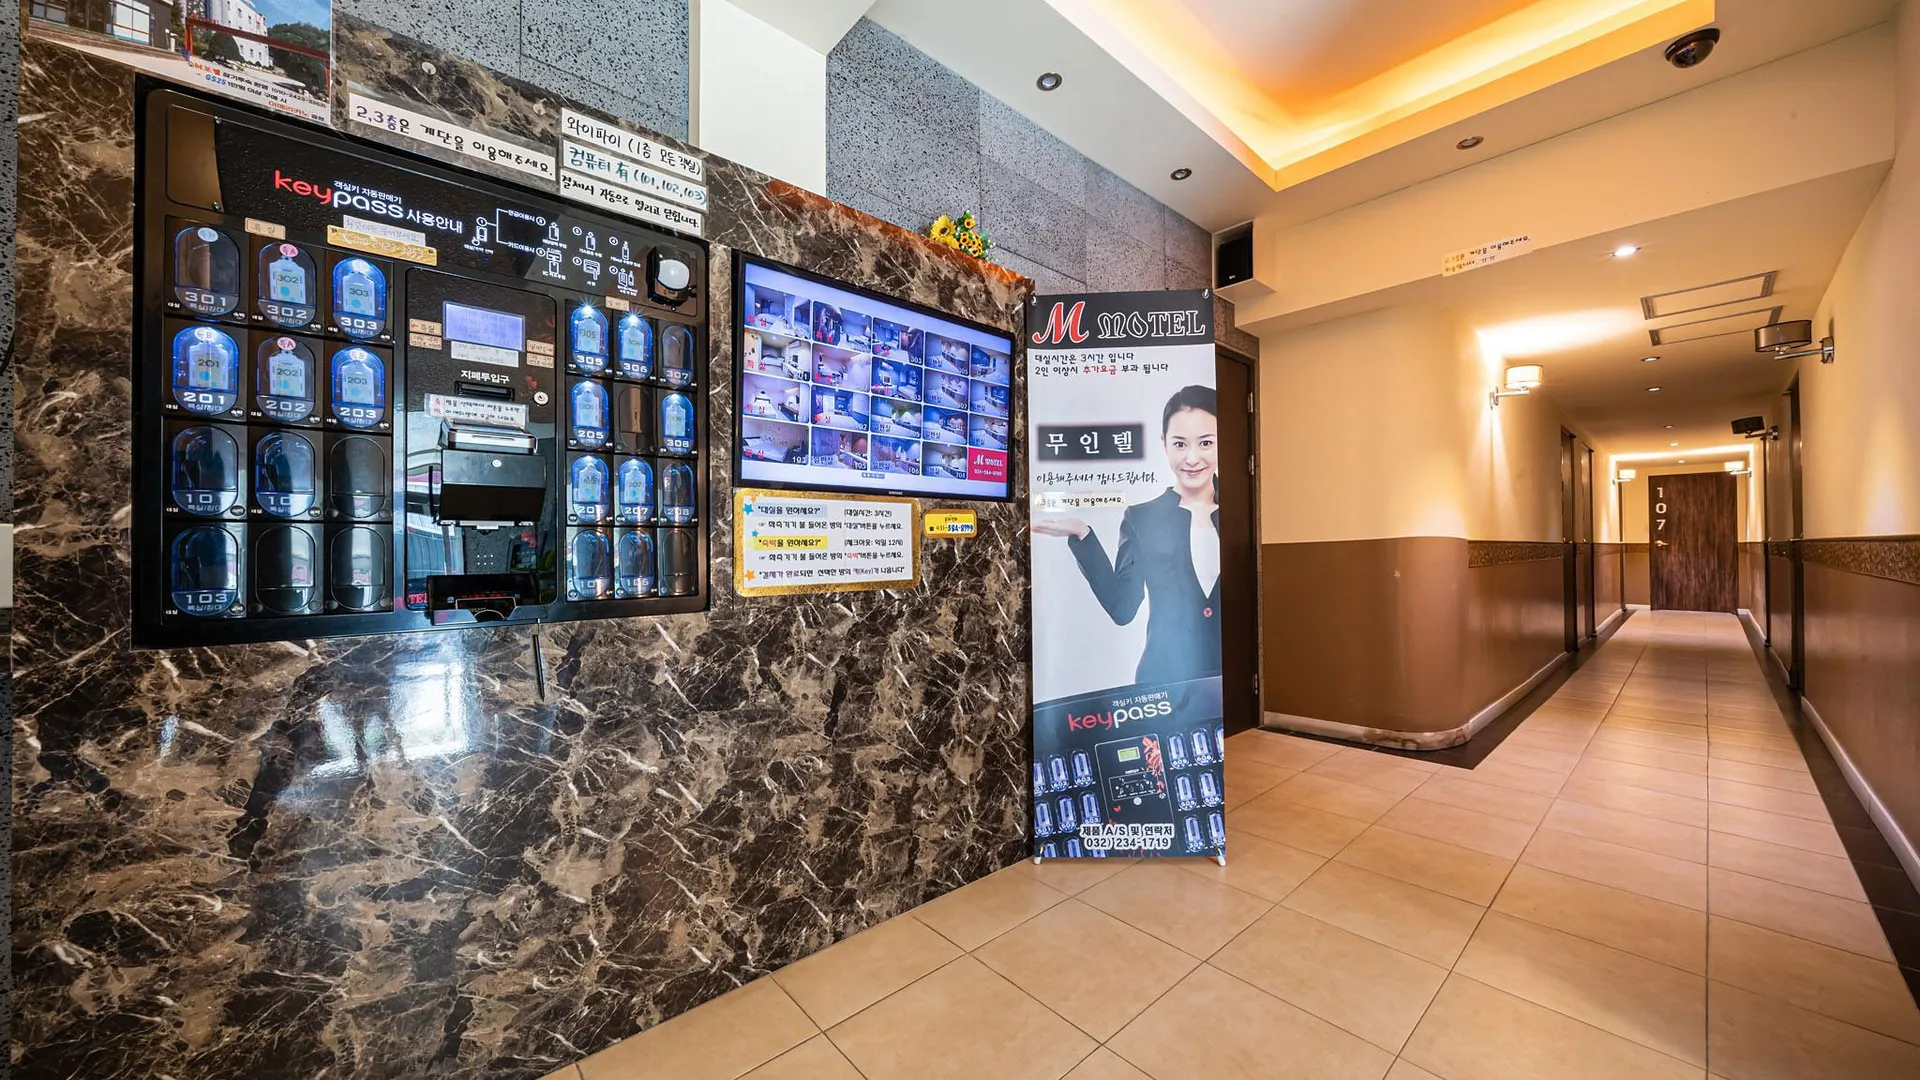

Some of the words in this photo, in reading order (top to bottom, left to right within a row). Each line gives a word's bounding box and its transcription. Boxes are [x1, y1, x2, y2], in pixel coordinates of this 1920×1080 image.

[205, 74, 226, 86] GS25
[356, 105, 410, 135] 2,3층은
[420, 124, 465, 152] 계단을
[472, 141, 554, 176] 이용해주세요.
[567, 116, 622, 148] 와이파이
[660, 149, 676, 167] 모든
[616, 161, 630, 183] 有
[274, 169, 404, 220] keypass
[334, 180, 360, 194] 객실키
[361, 187, 402, 205] 자동판매기
[561, 174, 595, 195] 결제시
[600, 188, 629, 206] 자동으로
[406, 209, 463, 234] 사용안내
[277, 273, 298, 285] 302
[348, 287, 369, 297] 303
[185, 291, 227, 307] 301
[267, 304, 308, 319] 302
[341, 316, 377, 330] 303
[1031, 300, 1089, 344] M
[1096, 310, 1207, 339] MOTEL
[198, 359, 220, 369] 201
[576, 354, 603, 367] 305
[1035, 353, 1077, 365] 대실시간은
[1080, 353, 1103, 364] 3시간
[1108, 352, 1135, 364] 입니다
[276, 368, 298, 377] 202
[623, 362, 648, 373] 306
[1034, 366, 1049, 377] 2인
[1053, 365, 1078, 377] 이상시
[1083, 364, 1117, 375] 추가요금
[1121, 364, 1139, 373] 부과
[1142, 363, 1169, 374] 됩니다
[347, 376, 368, 385] 203
[460, 369, 510, 384] 지폐투입구
[666, 370, 689, 380] 307
[183, 392, 225, 405] 201
[265, 400, 306, 412] 202
[340, 407, 376, 418] 203
[577, 430, 604, 440] 205
[666, 439, 690, 448] 308
[973, 454, 985, 466] M
[1036, 471, 1094, 486] 이용해주셔서
[1096, 471, 1158, 486] 감사드립니다.
[1655, 487, 1667, 531] 107
[185, 593, 228, 603] 103
[1112, 696, 1133, 708] 객실키
[1134, 690, 1169, 704] 자동판매기
[1067, 700, 1172, 732] keypass
[1082, 825, 1101, 837] 제품
[1106, 825, 1126, 837] A/S
[1131, 825, 1141, 837] 및
[1115, 837, 1169, 850] 234-1719
